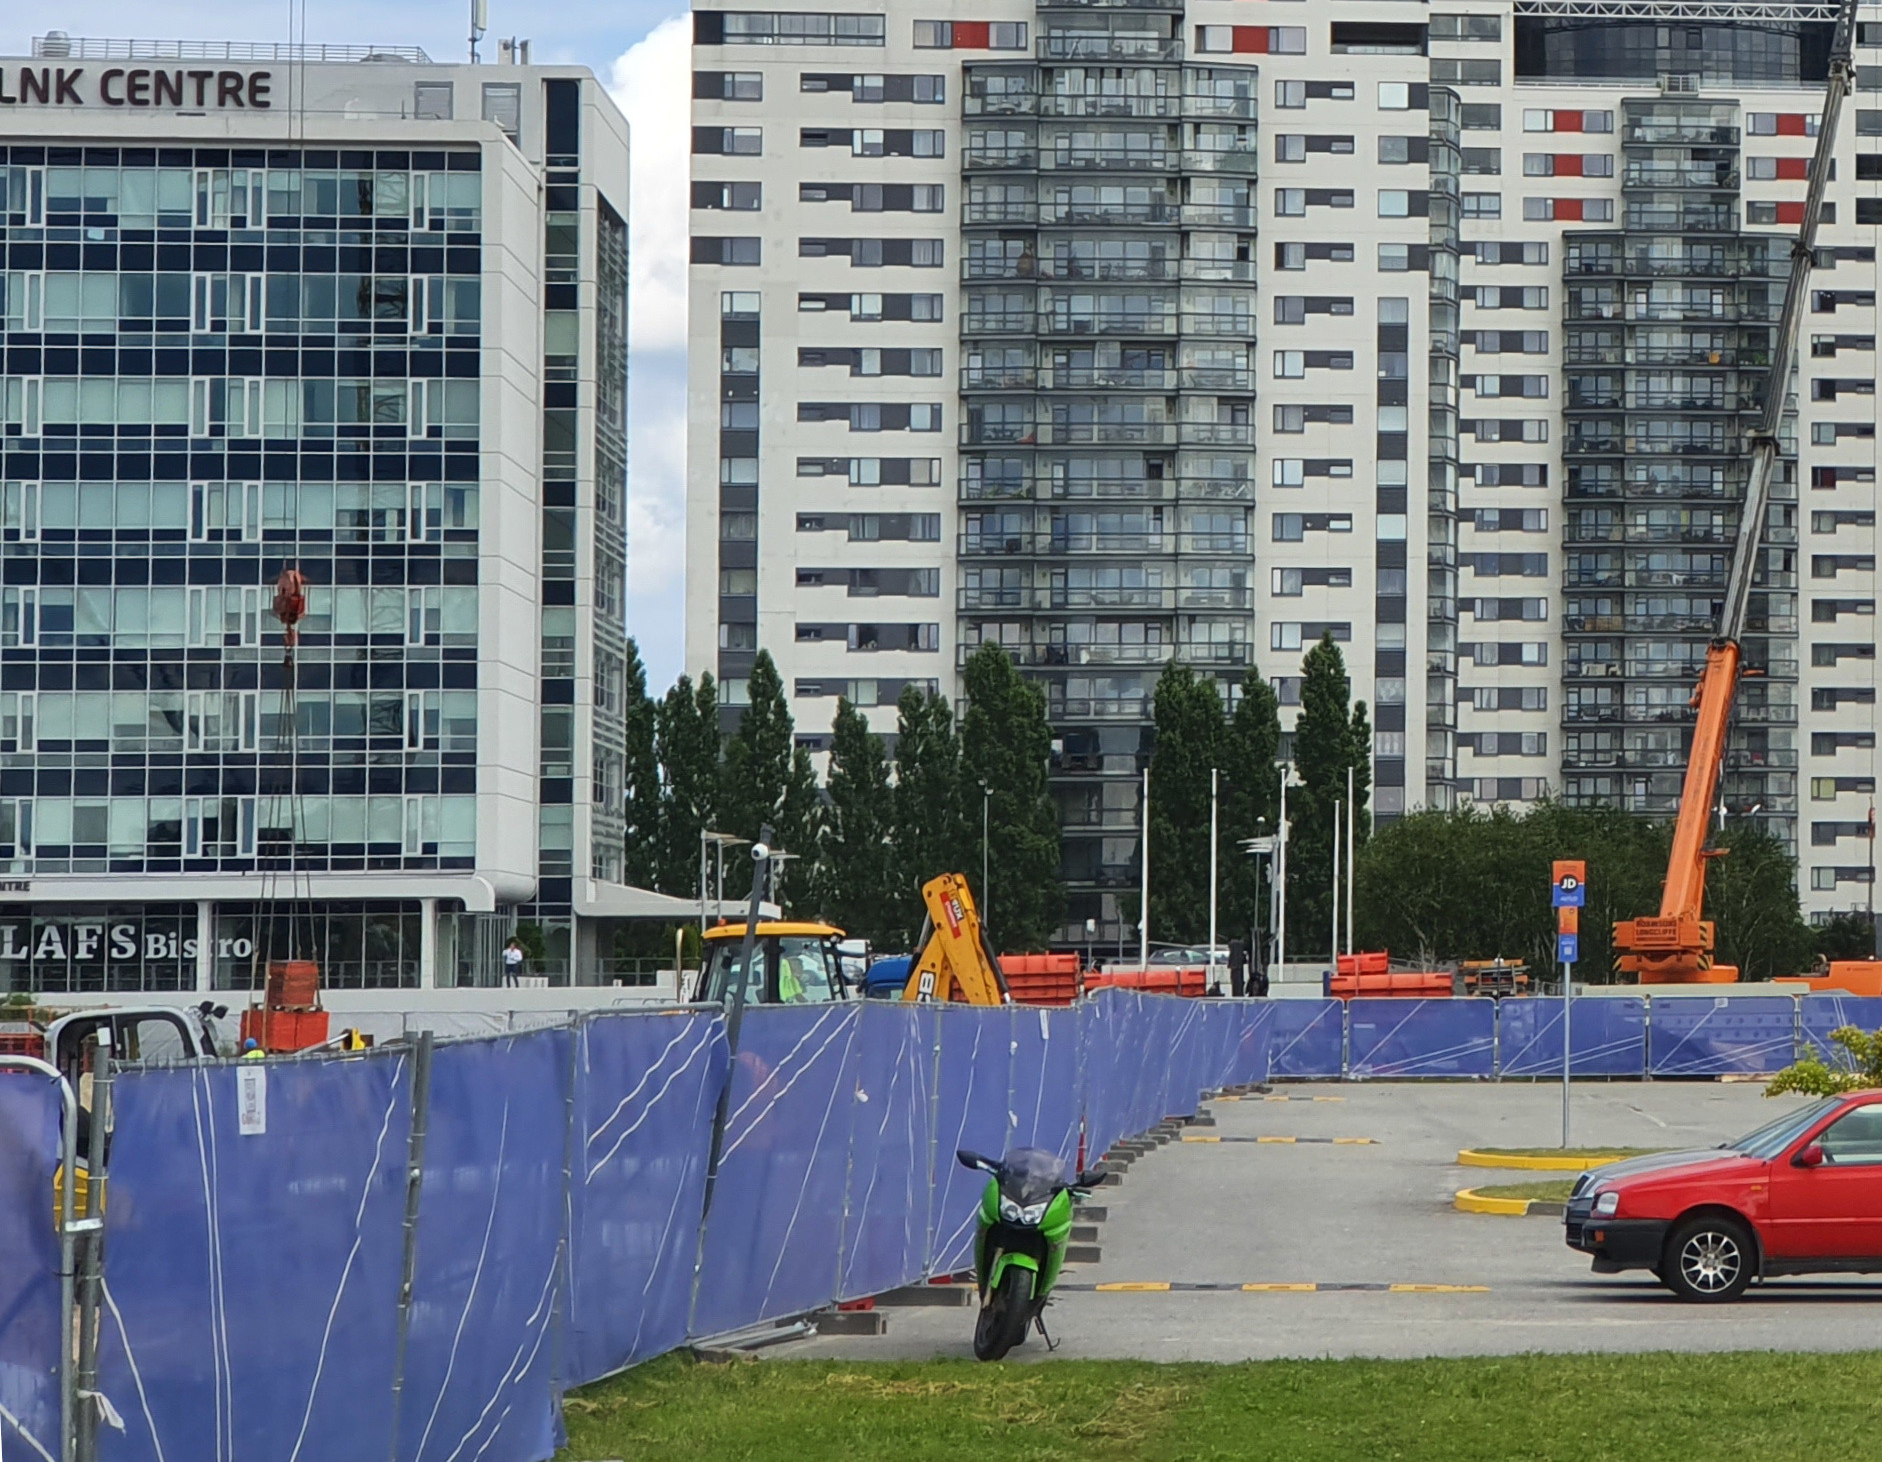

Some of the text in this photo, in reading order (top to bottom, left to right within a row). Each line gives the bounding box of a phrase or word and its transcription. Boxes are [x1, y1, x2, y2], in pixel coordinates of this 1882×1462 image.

[0, 67, 271, 108] LNK CENTRE
[1561, 877, 1577, 889] JD
[0, 925, 252, 960] LAFS Bisro
